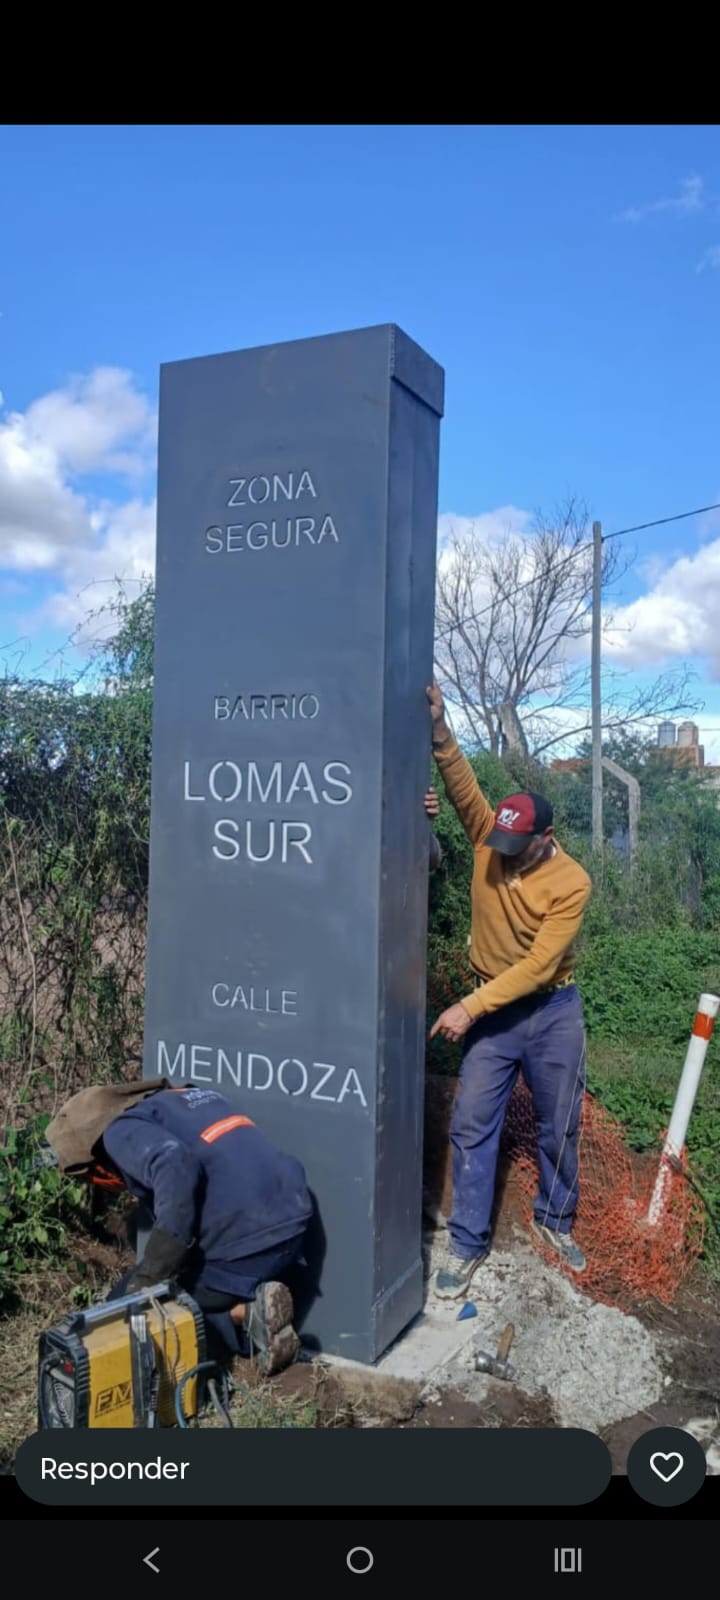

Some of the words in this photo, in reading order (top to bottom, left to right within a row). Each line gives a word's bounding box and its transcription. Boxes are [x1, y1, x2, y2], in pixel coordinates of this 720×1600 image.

[227, 470, 317, 507] ZONA
[205, 514, 339, 554] SEGURA
[214, 694, 319, 720] BARRIO
[184, 760, 353, 805] LOMAS
[212, 818, 313, 864] SUR
[212, 983, 297, 1015] CALLE
[157, 1040, 368, 1107] MENDOZA
